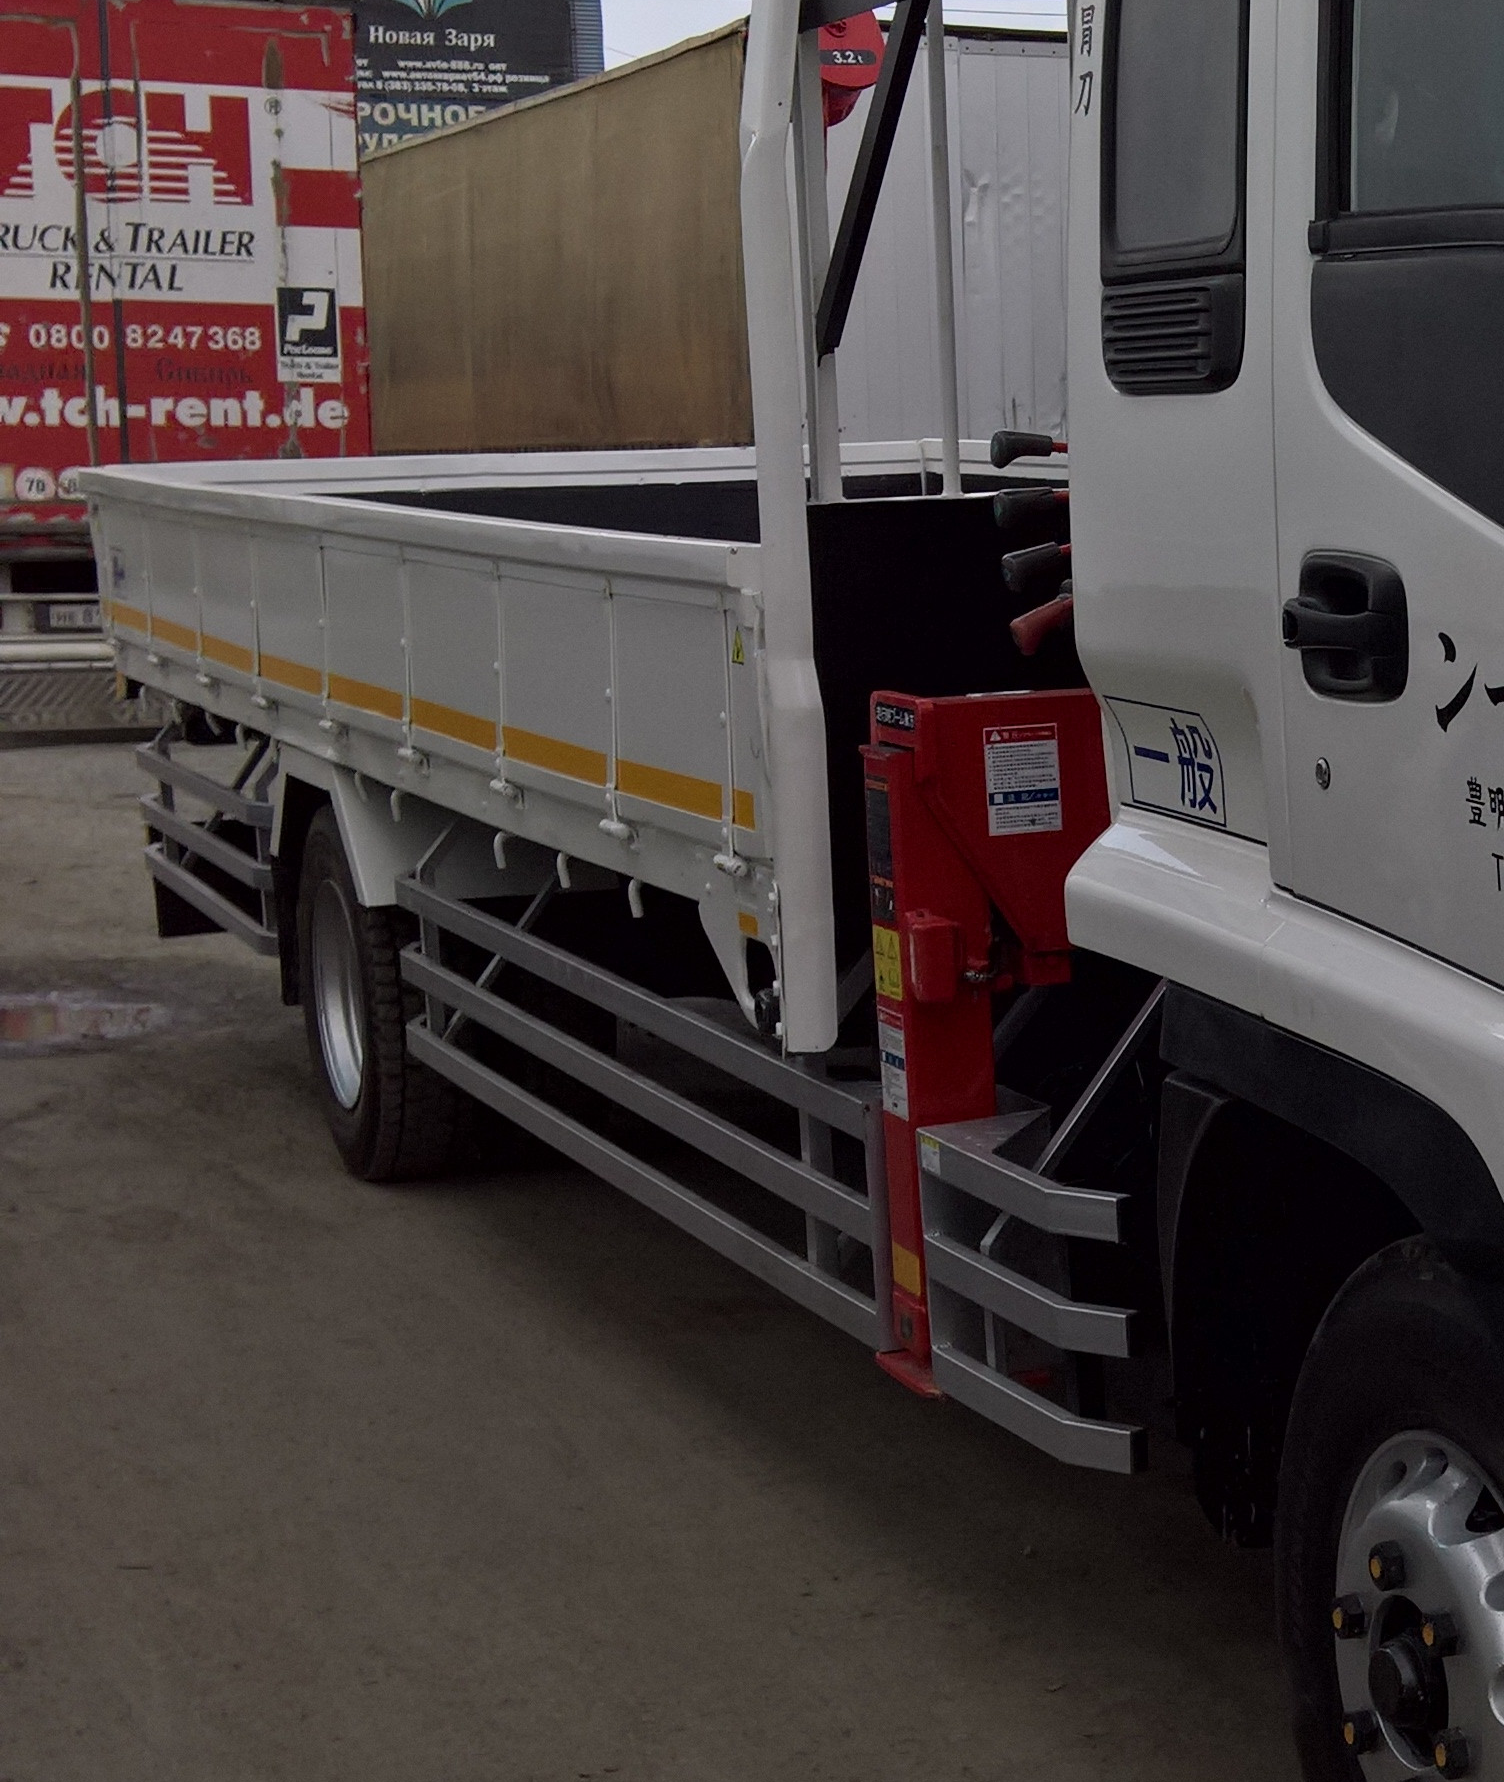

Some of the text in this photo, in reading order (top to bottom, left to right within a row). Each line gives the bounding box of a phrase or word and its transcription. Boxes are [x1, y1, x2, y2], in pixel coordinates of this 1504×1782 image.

[368, 24, 496, 52] Новая Заря
[832, 50, 864, 65] 3.2t
[92, 229, 116, 254] &
[125, 222, 255, 257] TRAILER
[29, 323, 110, 350] 0800
[125, 323, 262, 351] 8247368
